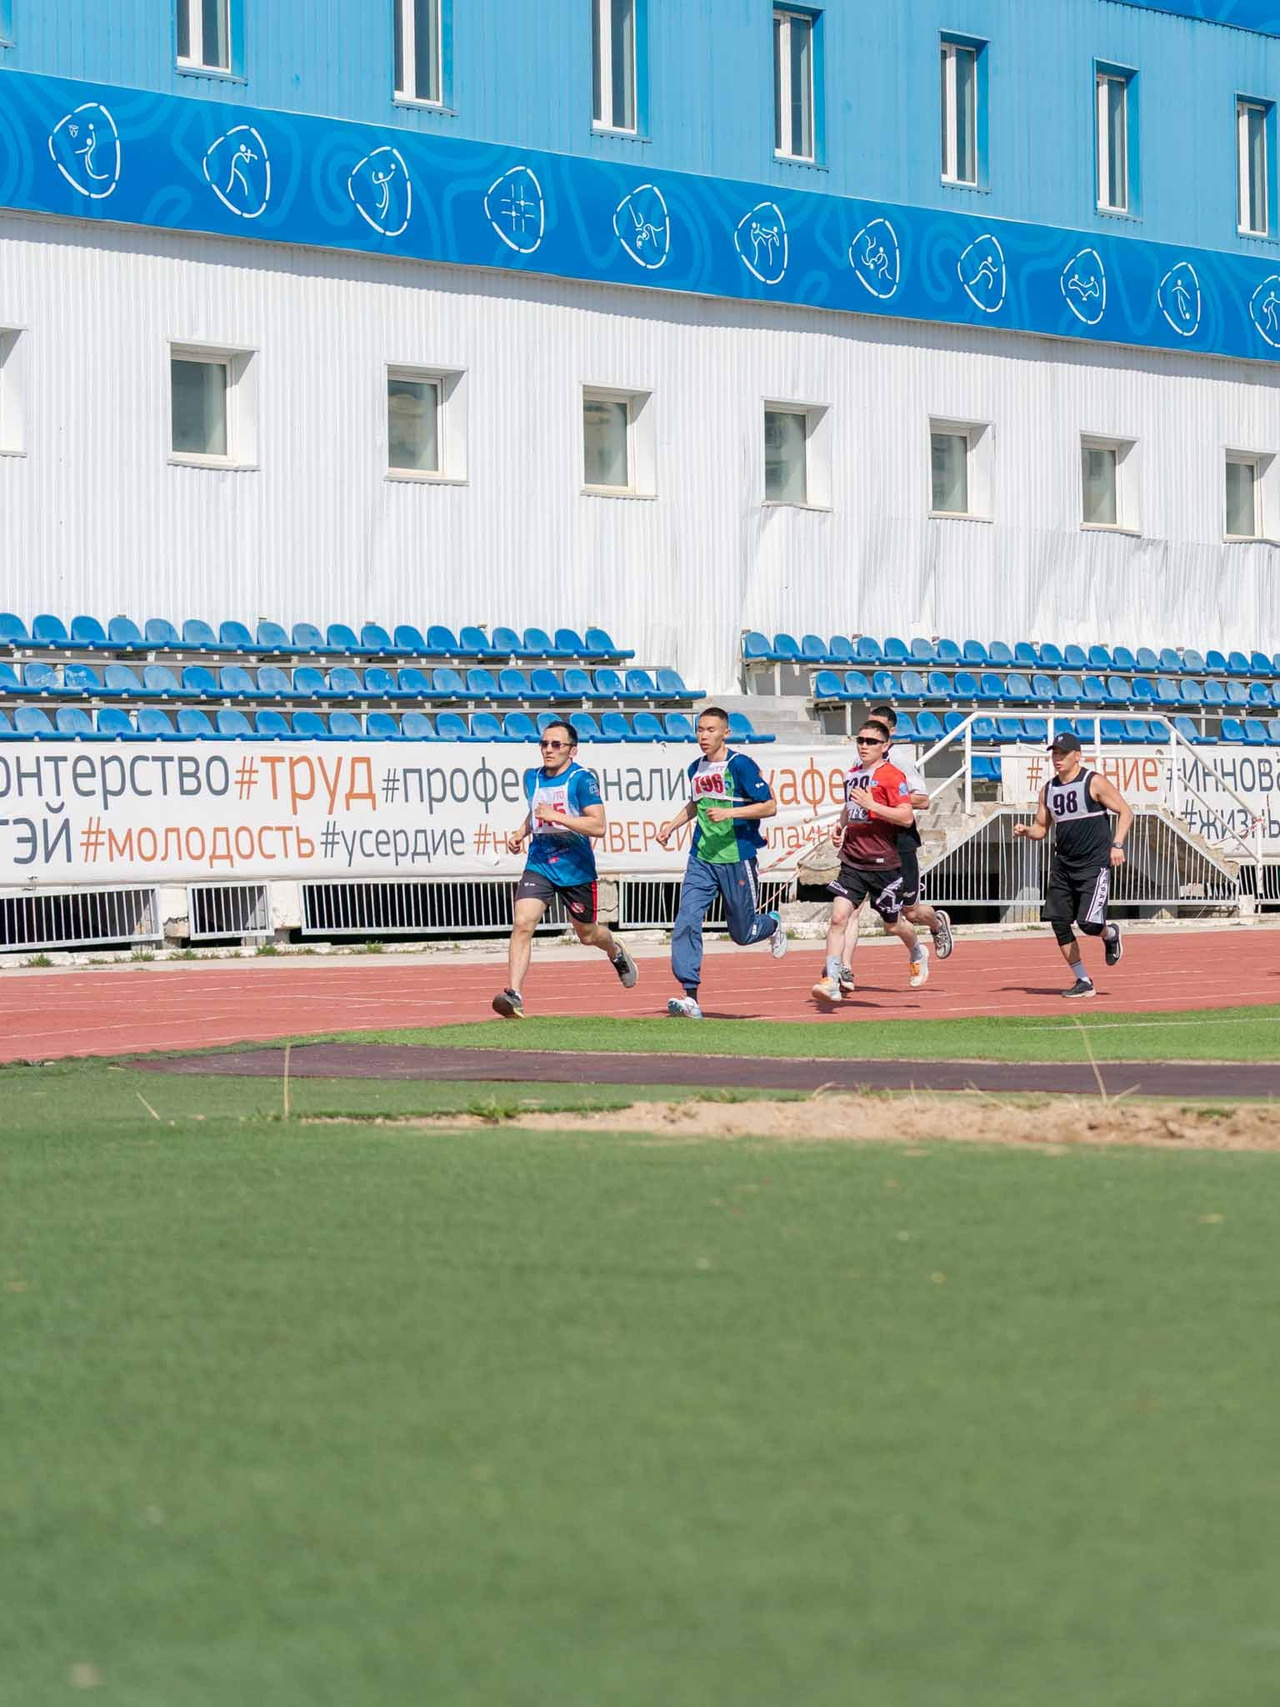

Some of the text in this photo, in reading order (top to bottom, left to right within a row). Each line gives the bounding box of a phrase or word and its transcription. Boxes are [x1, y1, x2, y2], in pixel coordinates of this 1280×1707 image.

[234, 755, 377, 815] #труд
[694, 773, 724, 795] 196
[1053, 790, 1078, 816] 98
[0, 801, 72, 865] эй
[80, 817, 315, 869] #молодость
[320, 821, 465, 868] #усердие
